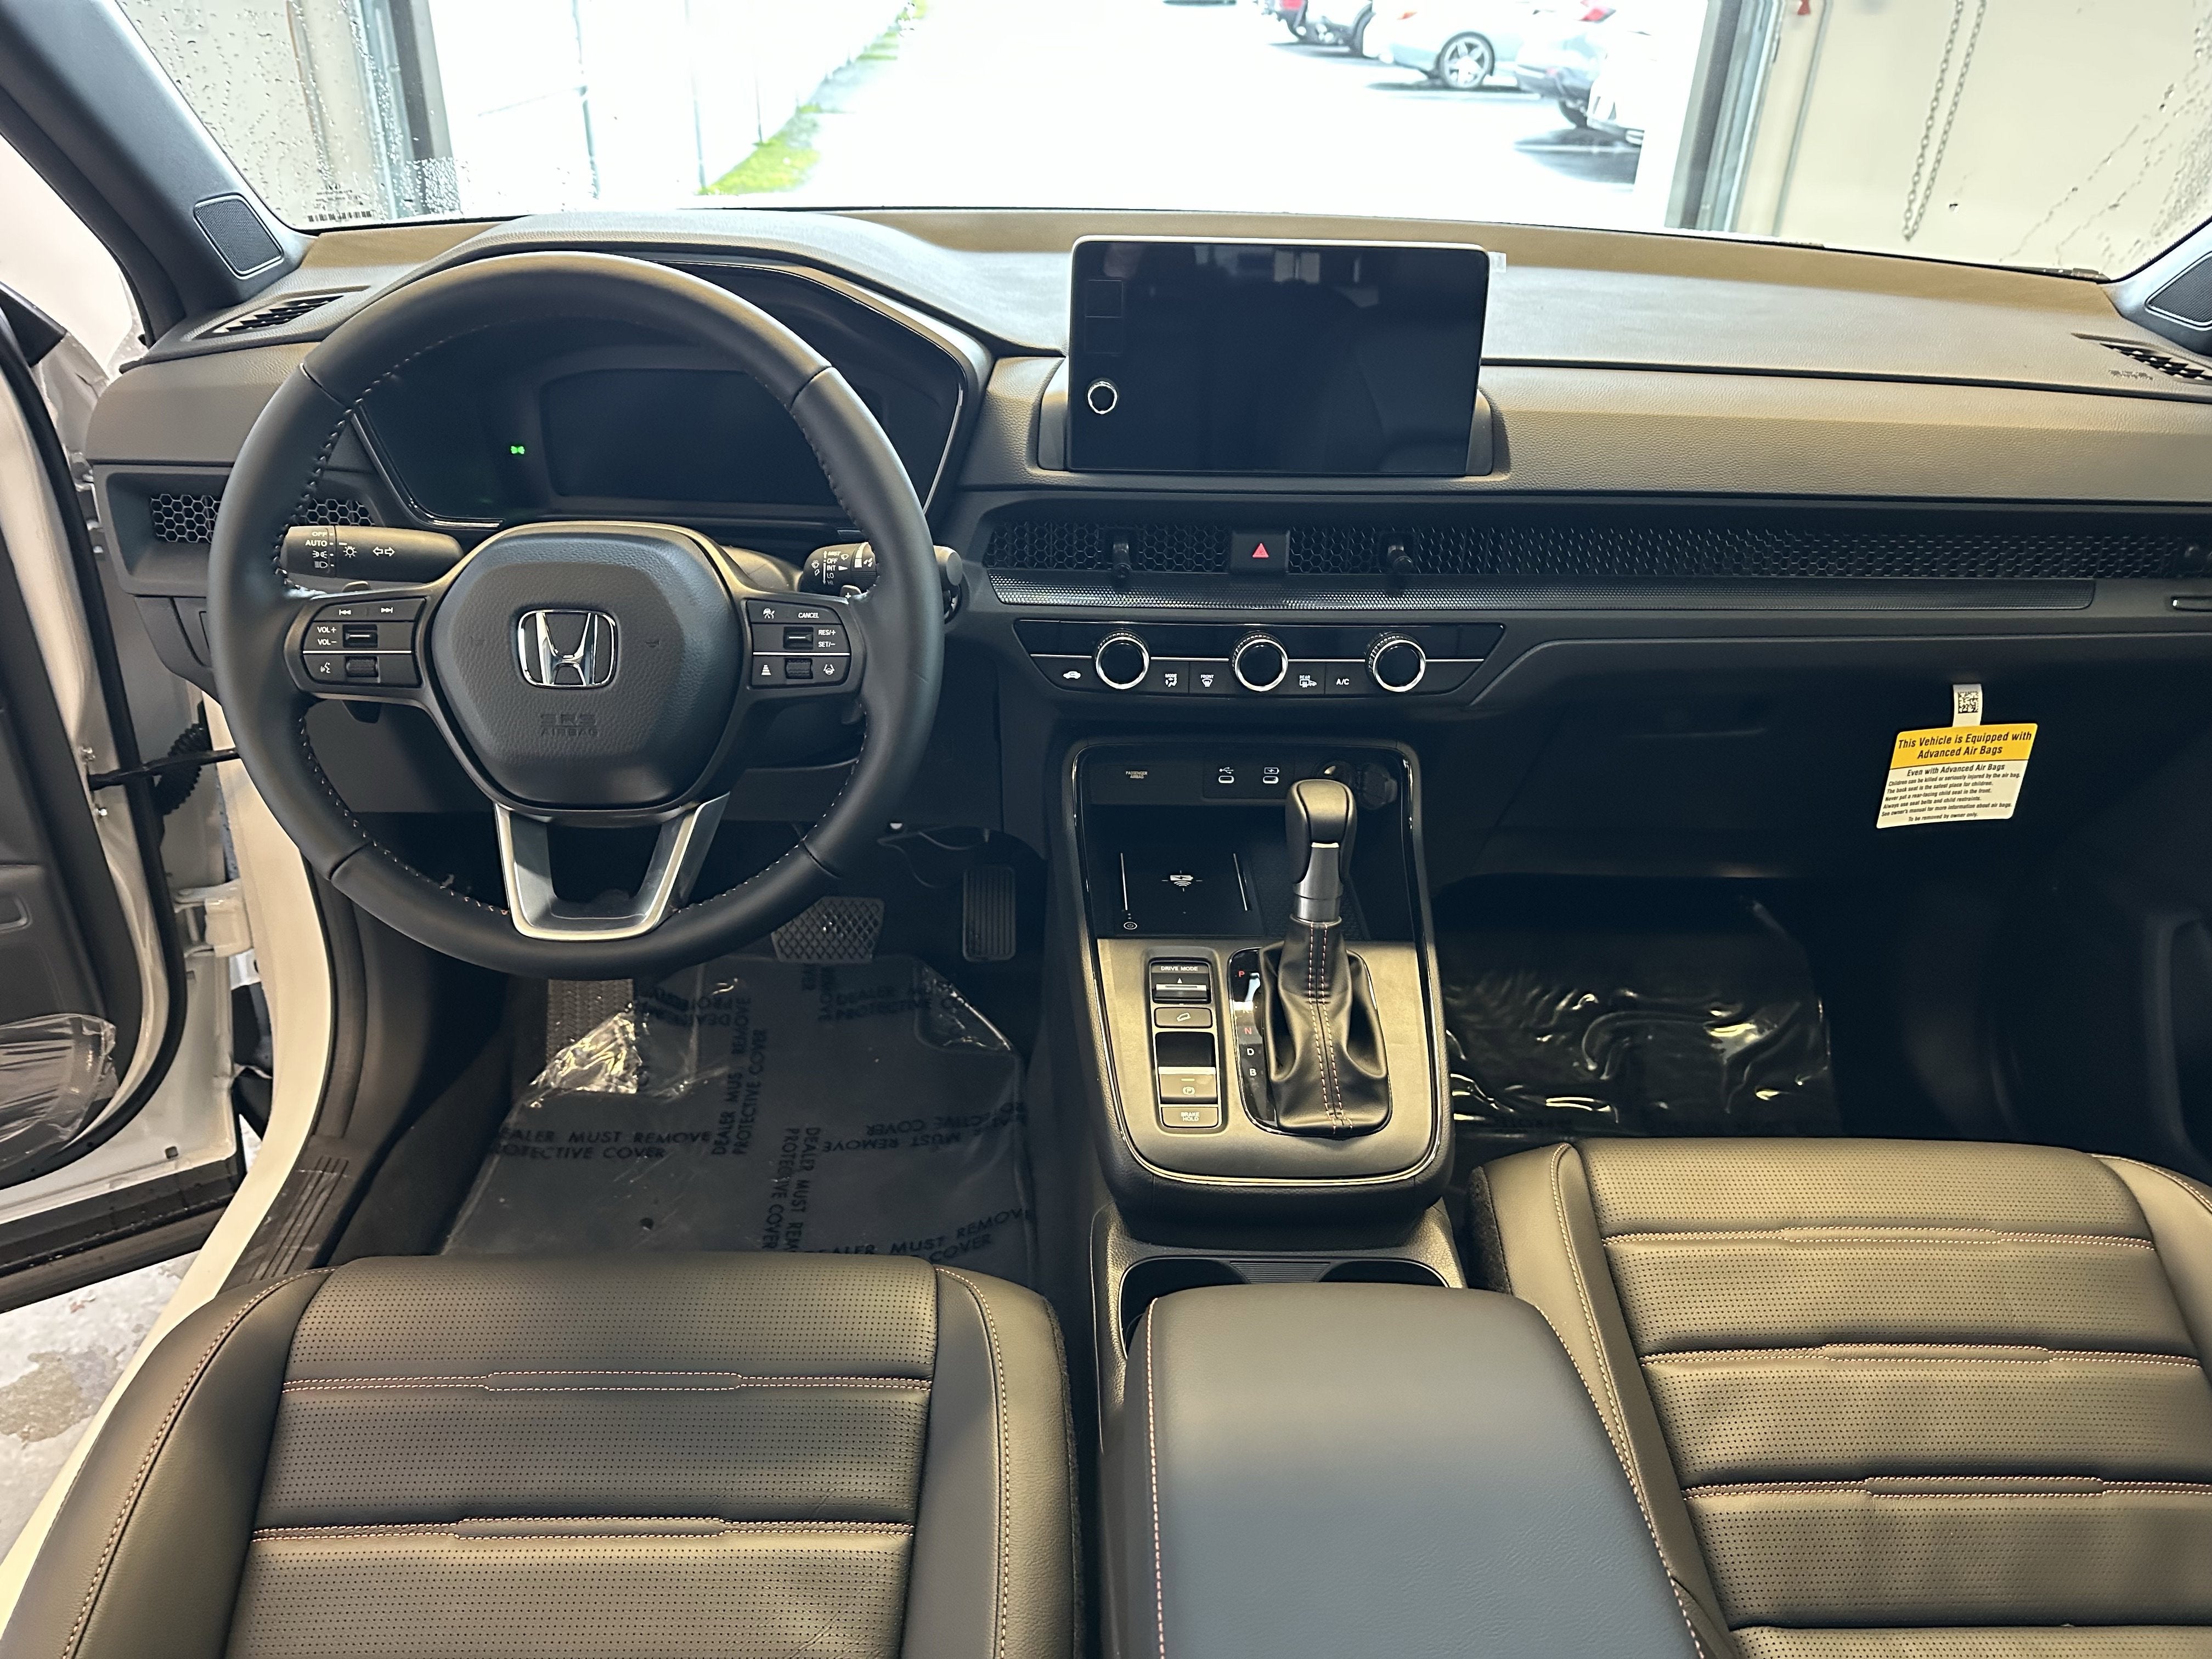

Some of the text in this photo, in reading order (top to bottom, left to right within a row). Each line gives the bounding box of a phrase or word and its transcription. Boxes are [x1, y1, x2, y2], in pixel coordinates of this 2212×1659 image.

[540, 714, 597, 725] SRS
[540, 728, 600, 736] AIRBAG
[1899, 731, 2032, 749] This Vehicle is Equipped with
[1917, 746, 2003, 759] Advanced Air Bags
[1940, 765, 1974, 774] Advanced
[732, 1082, 761, 1155] PROTECTIVE
[568, 1131, 621, 1142] MUST
[633, 1131, 712, 1143] REMOVE
[712, 1111, 736, 1155] DEALER
[603, 1147, 664, 1159] COVER
[799, 1127, 822, 1171] DEALER
[823, 1136, 899, 1153] REMOVE
[791, 1180, 810, 1212] MUST
[761, 1204, 785, 1250] COVER
[890, 1235, 945, 1255] MUST
